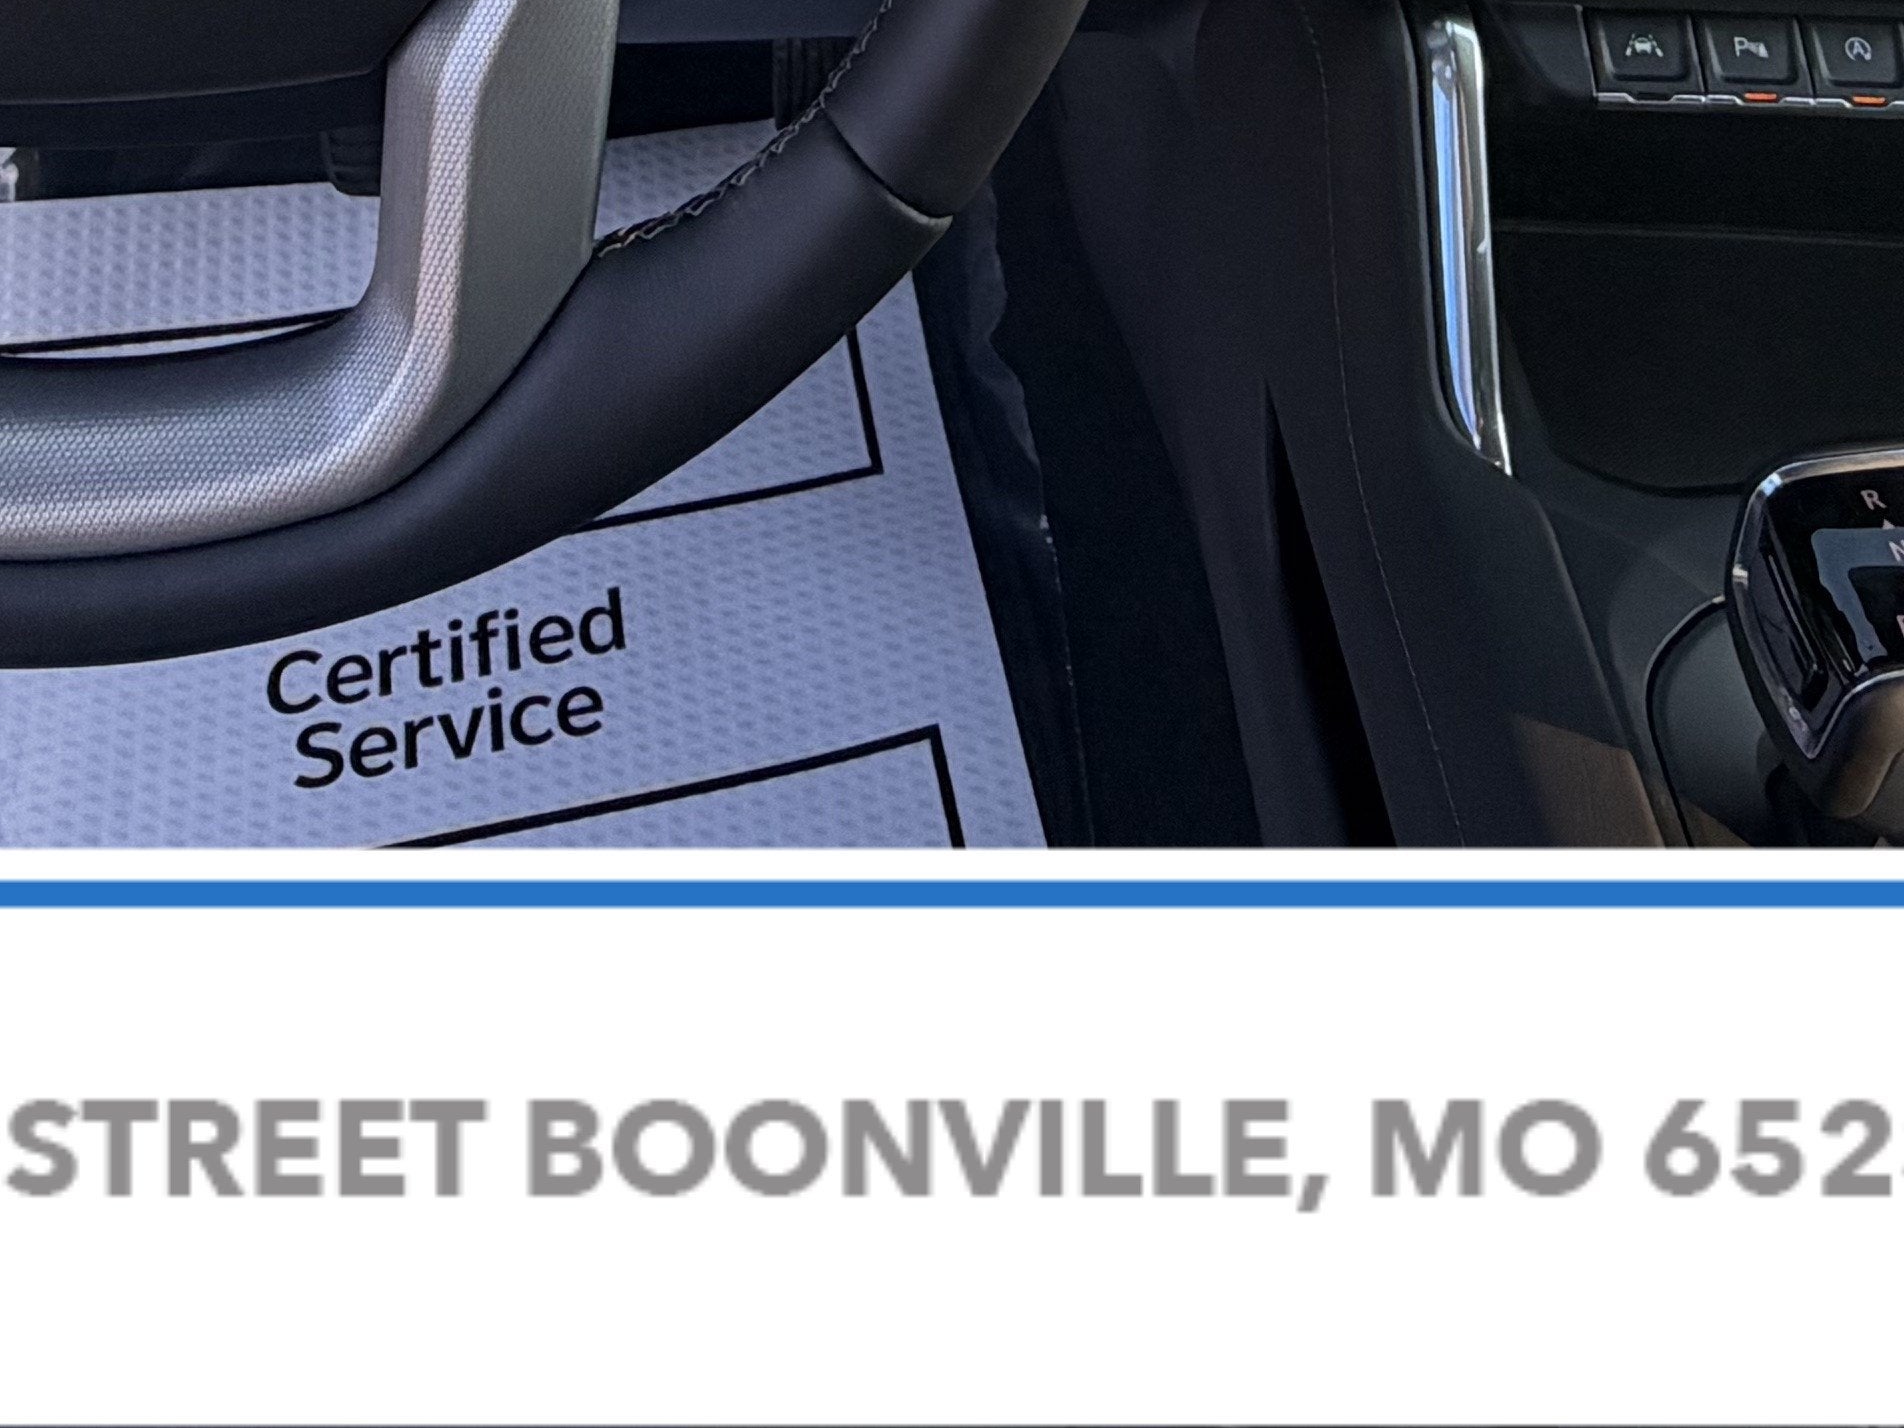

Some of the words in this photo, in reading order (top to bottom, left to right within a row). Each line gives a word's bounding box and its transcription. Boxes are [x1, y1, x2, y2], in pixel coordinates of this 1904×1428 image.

[1861, 490, 1886, 510] R
[265, 587, 628, 717] Certified
[293, 685, 605, 790] Service
